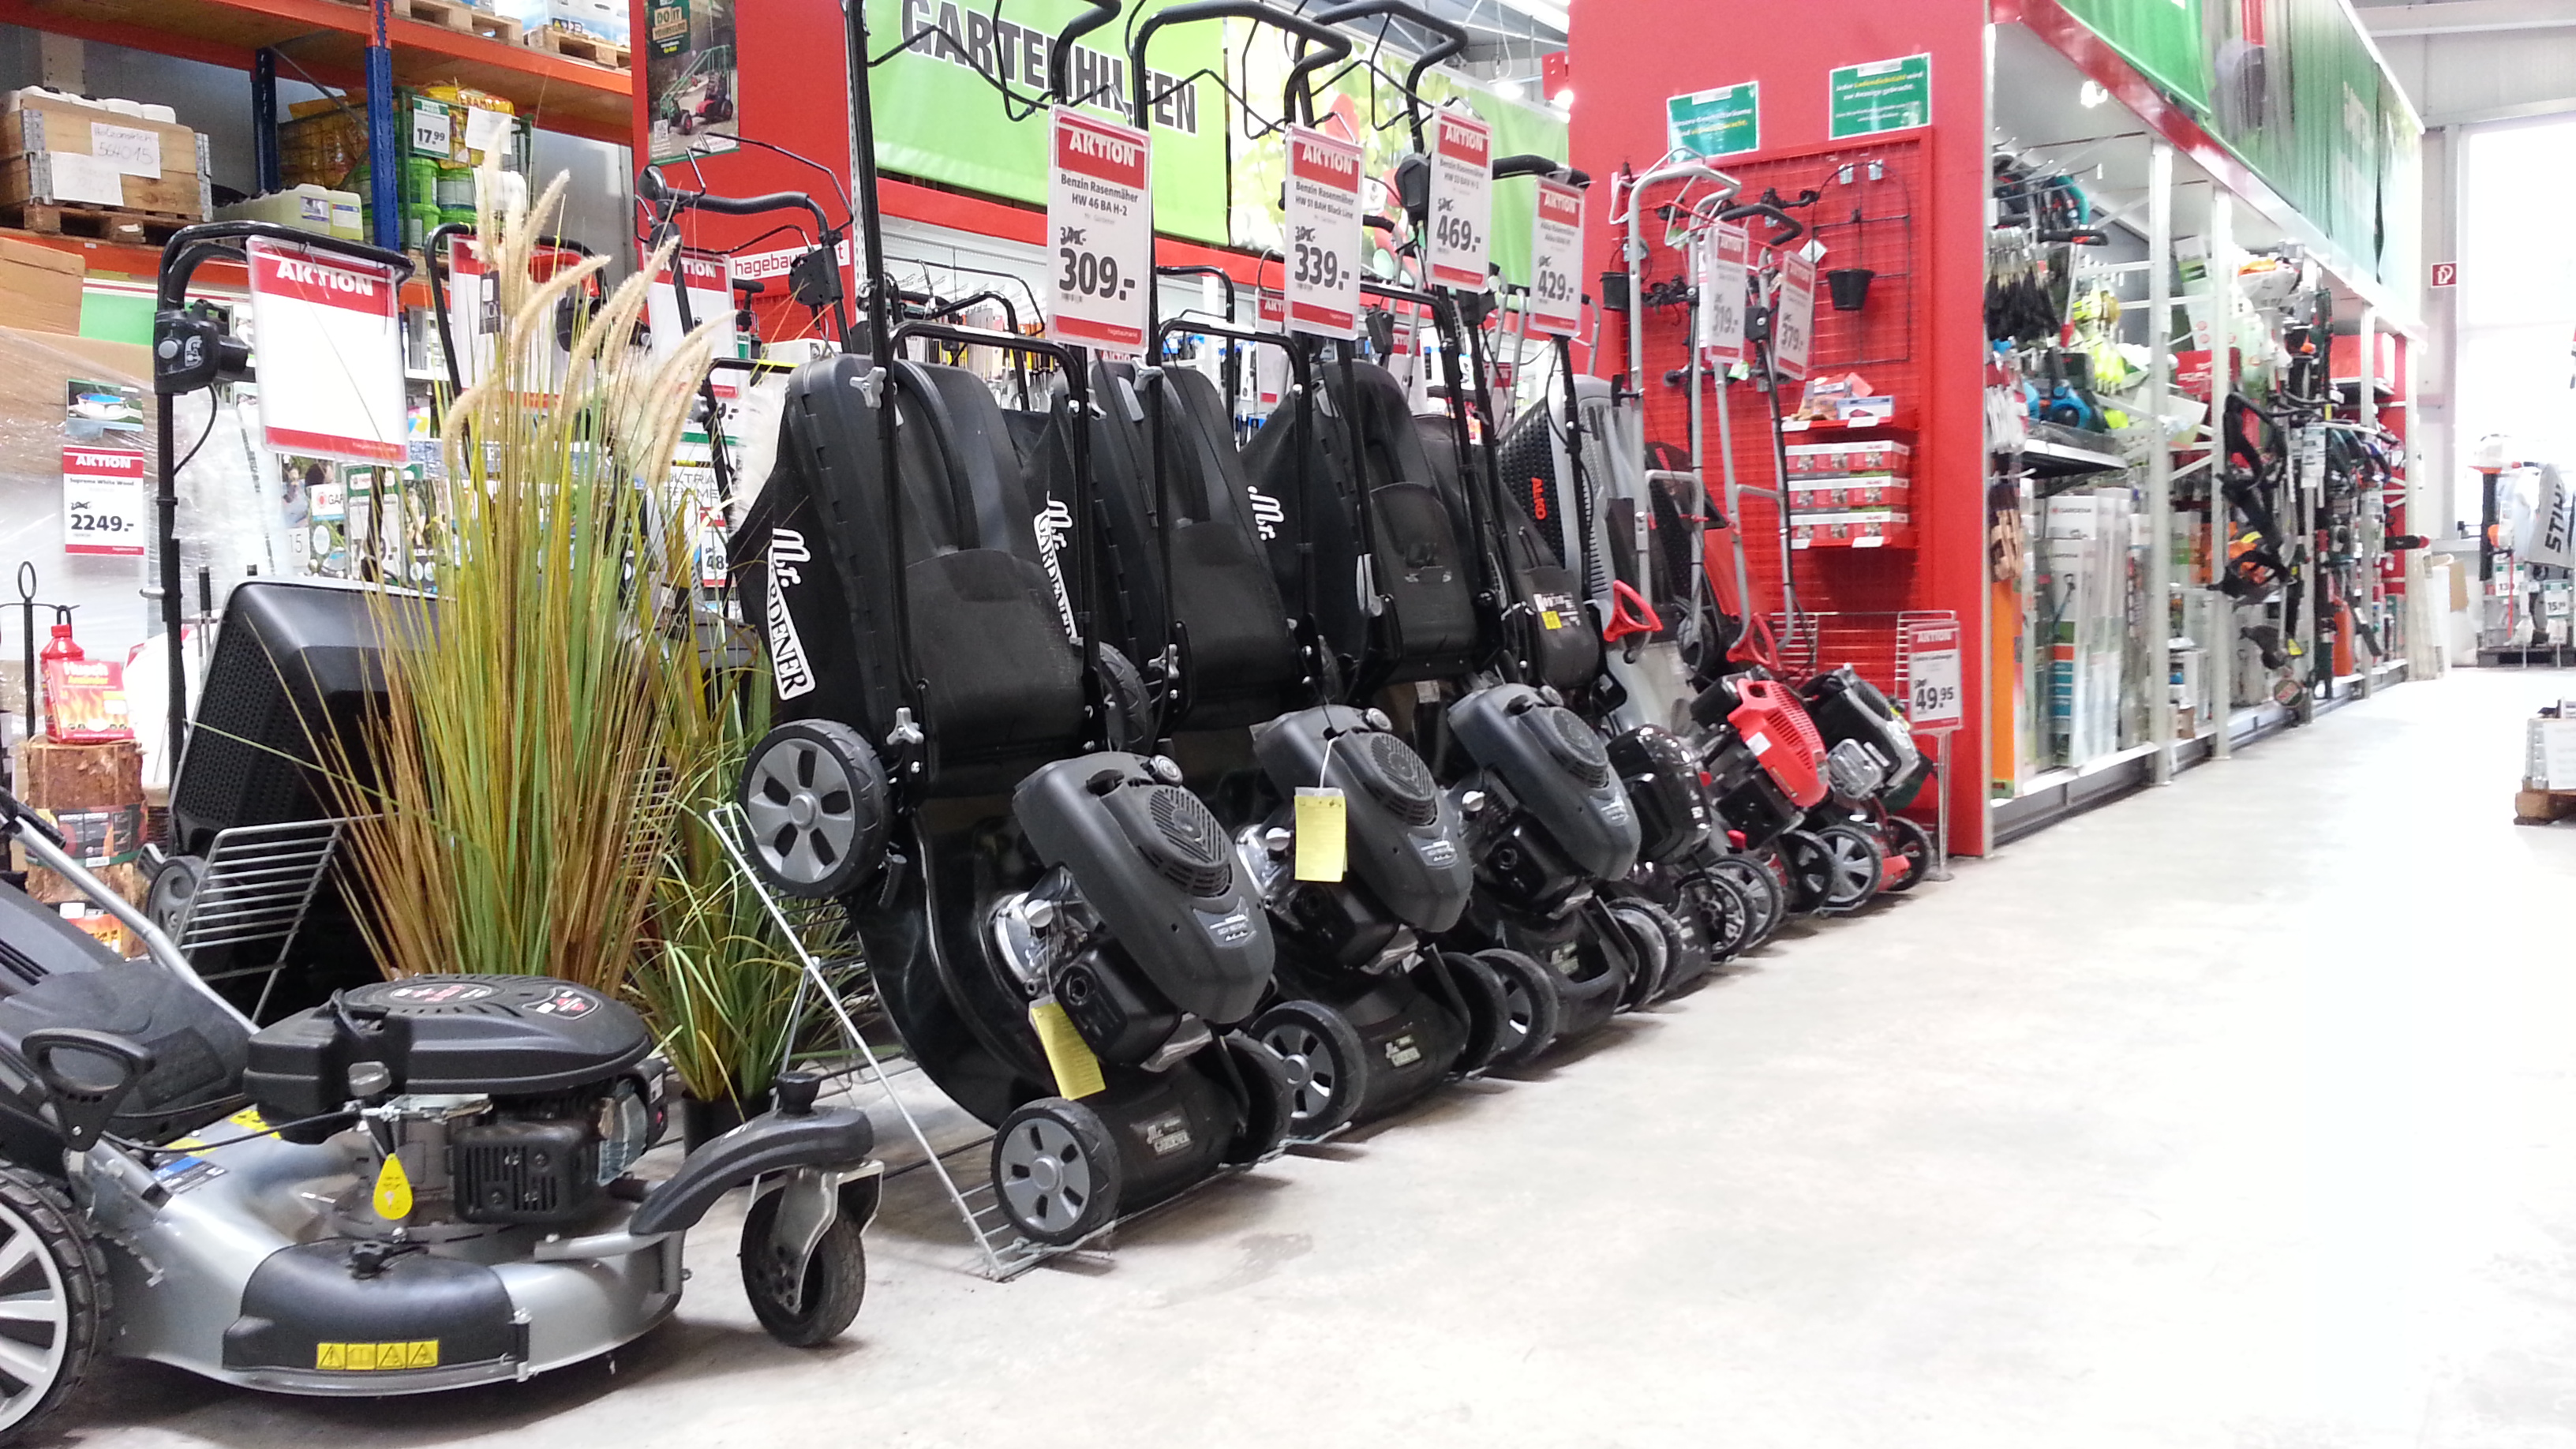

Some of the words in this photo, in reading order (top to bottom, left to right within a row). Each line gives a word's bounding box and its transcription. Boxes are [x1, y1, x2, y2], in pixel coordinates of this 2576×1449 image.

[657, 11, 670, 24] DO
[673, 9, 680, 21] IT
[902, 0, 1196, 134] GARTEHILEN
[1069, 130, 1136, 167] AKTION
[1445, 125, 1484, 152] AKTION
[1302, 144, 1353, 175] AKTION
[1061, 174, 1088, 191] Benzin
[1091, 182, 1138, 203] Rasenmäher
[1296, 181, 1317, 195] Benzin
[1319, 188, 1354, 205] Rasenmäher
[1544, 193, 1575, 214] AKTION
[1072, 193, 1087, 206] HW
[1088, 197, 1099, 209] 46
[1101, 202, 1112, 212] BA
[1114, 204, 1128, 216] H-2
[1437, 215, 1481, 253] 469.-
[660, 259, 716, 278] ATION
[735, 244, 844, 276] hagebat
[1059, 247, 1135, 301] 309.-
[1294, 243, 1350, 291] 339.-
[277, 258, 373, 297] AKTION
[1537, 270, 1574, 301] 429.-
[1102, 351, 1130, 361] AKTIO
[76, 455, 132, 469] AKTION
[71, 514, 134, 532] 2249.-
[1046, 489, 1073, 550] Mr.
[1247, 485, 1284, 541] Mr.
[772, 527, 811, 588] Mr.
[768, 551, 810, 696] RDENER
[1915, 686, 1953, 710] 49.95
